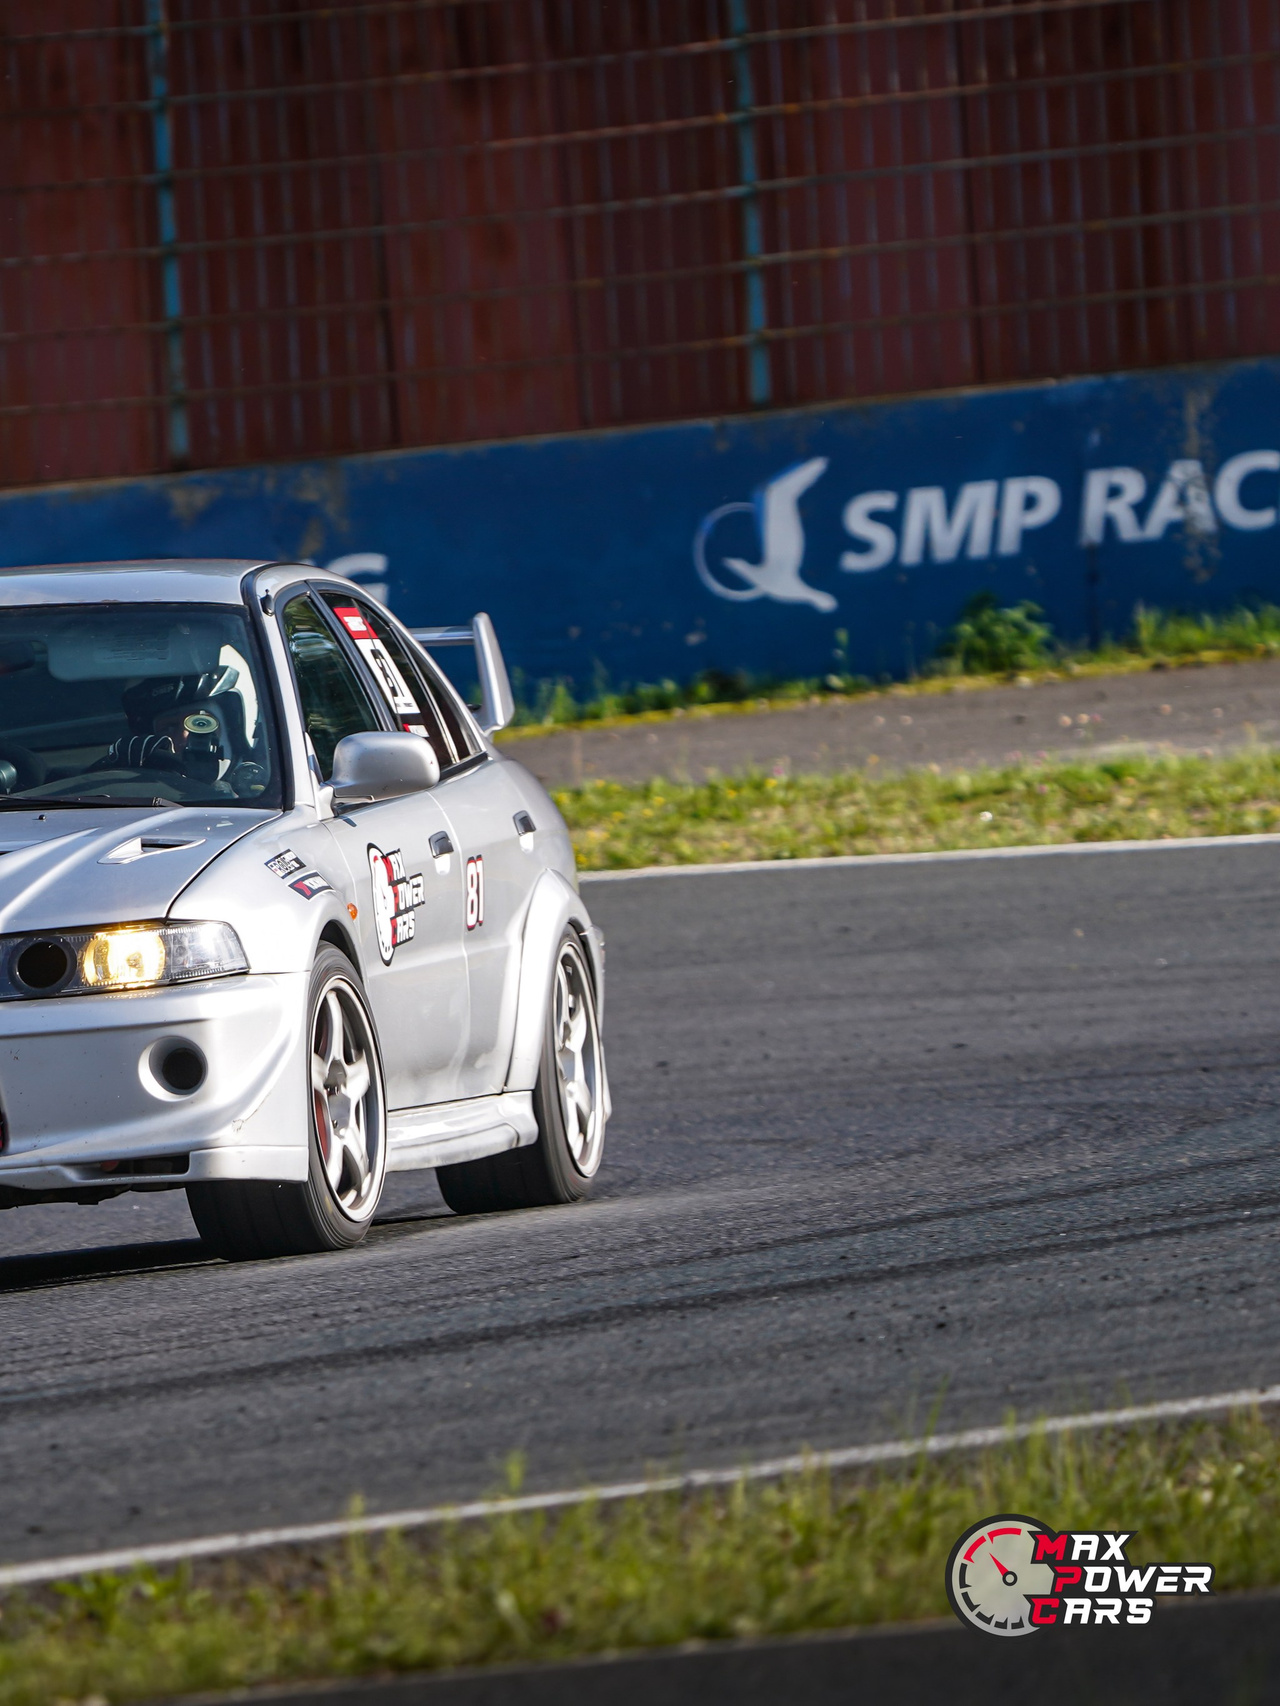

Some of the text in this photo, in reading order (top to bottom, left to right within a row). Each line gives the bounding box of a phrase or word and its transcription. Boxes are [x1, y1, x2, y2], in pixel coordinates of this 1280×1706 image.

[839, 449, 1280, 573] SMP RAC
[390, 909, 415, 946] CARS
[466, 855, 483, 930] 81
